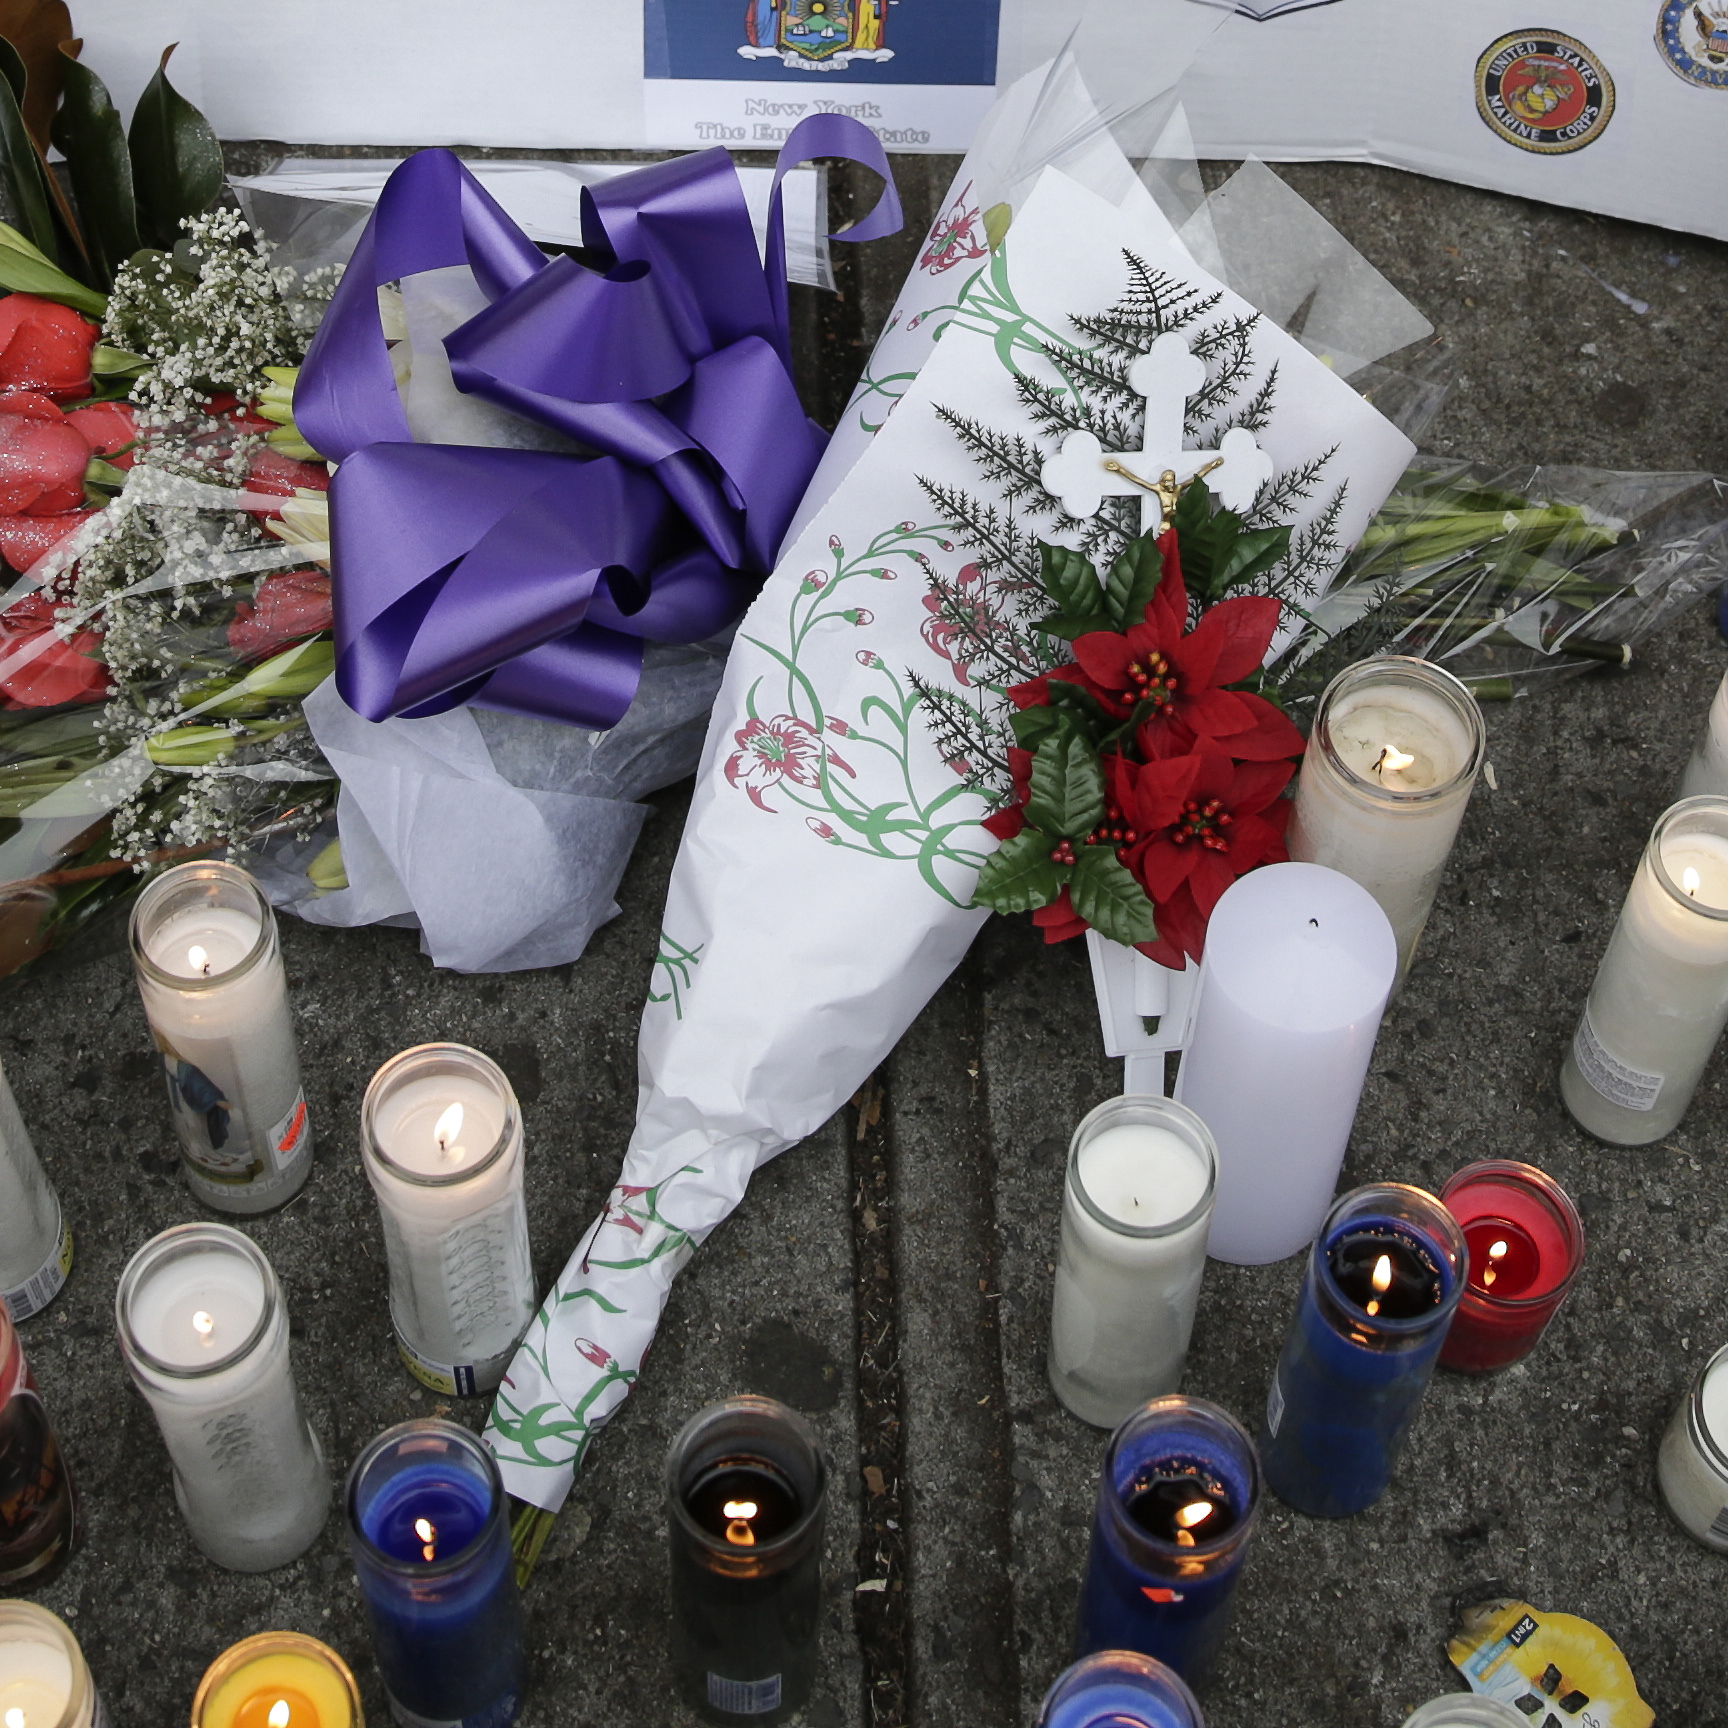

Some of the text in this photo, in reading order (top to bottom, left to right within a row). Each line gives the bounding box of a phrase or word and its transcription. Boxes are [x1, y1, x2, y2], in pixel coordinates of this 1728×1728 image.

[1489, 42, 1598, 87] UNITED STATES
[745, 98, 808, 118] New
[1488, 95, 1598, 141] MARINE CORPS
[696, 121, 746, 140] The
[1510, 1617, 1534, 1644] 2IN1
